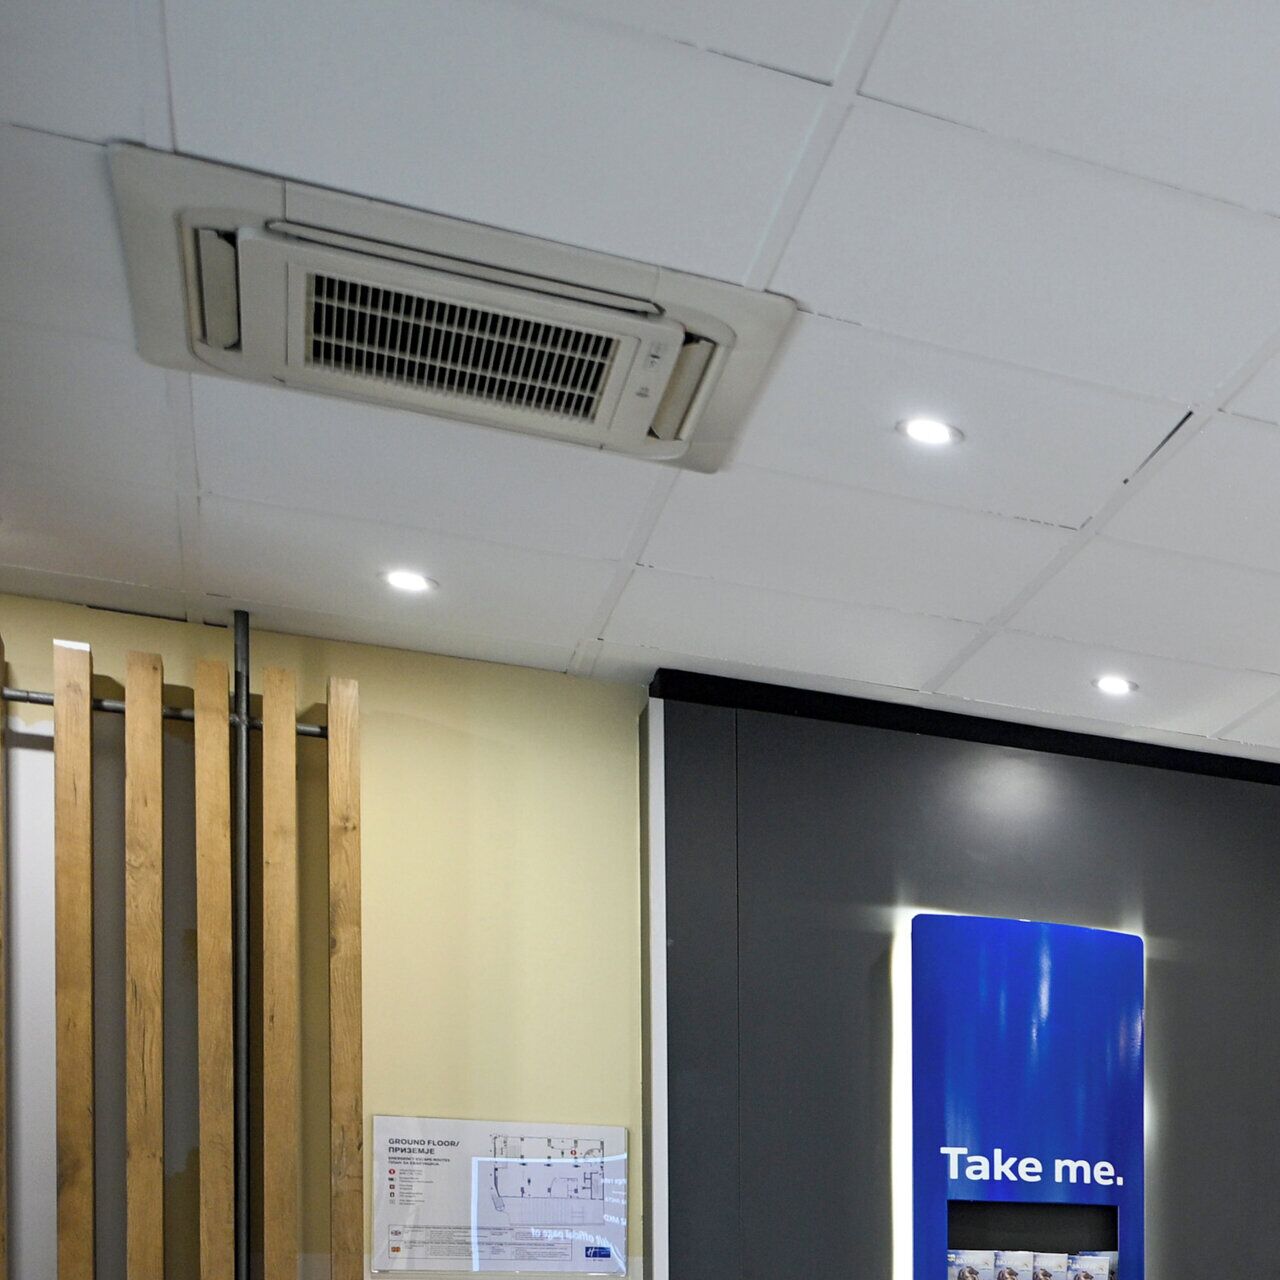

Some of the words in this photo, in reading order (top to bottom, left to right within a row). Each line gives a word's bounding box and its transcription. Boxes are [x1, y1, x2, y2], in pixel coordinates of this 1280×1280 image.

[388, 1138, 425, 1146] GROUND
[939, 1146, 1043, 1183] Take
[1054, 1158, 1124, 1187] me.
